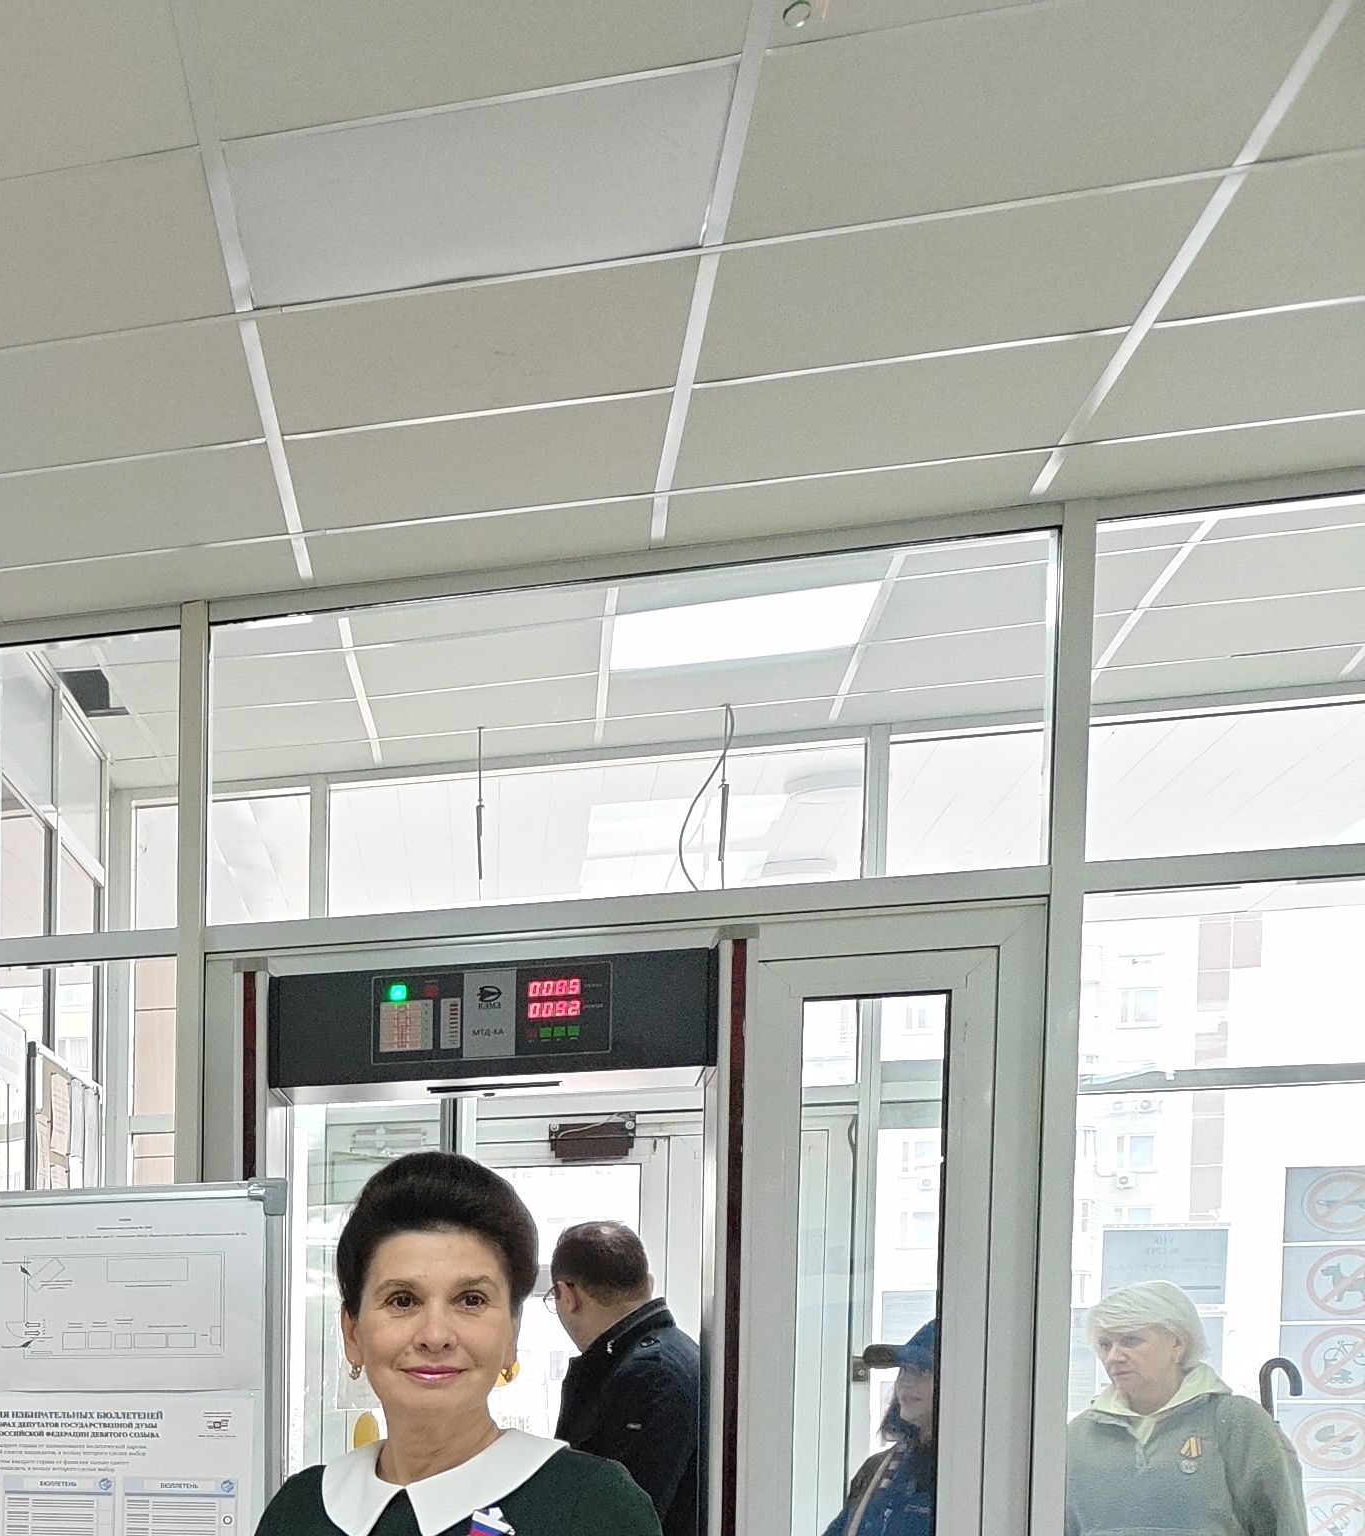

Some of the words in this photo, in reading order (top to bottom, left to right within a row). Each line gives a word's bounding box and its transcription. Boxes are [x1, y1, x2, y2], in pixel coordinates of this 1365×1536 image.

[472, 1028, 504, 1037] МТД-КА
[11, 1411, 95, 1420] ИЗБИРАТЕЛЬНЫХ
[96, 1410, 164, 1420] БЮЛЛЕТЕНЕЙ
[61, 1421, 132, 1430] ГОСУДАРСТВЕННОЙ
[134, 1422, 157, 1430] ДУМЫ
[128, 1431, 160, 1439] СОЗЫВА
